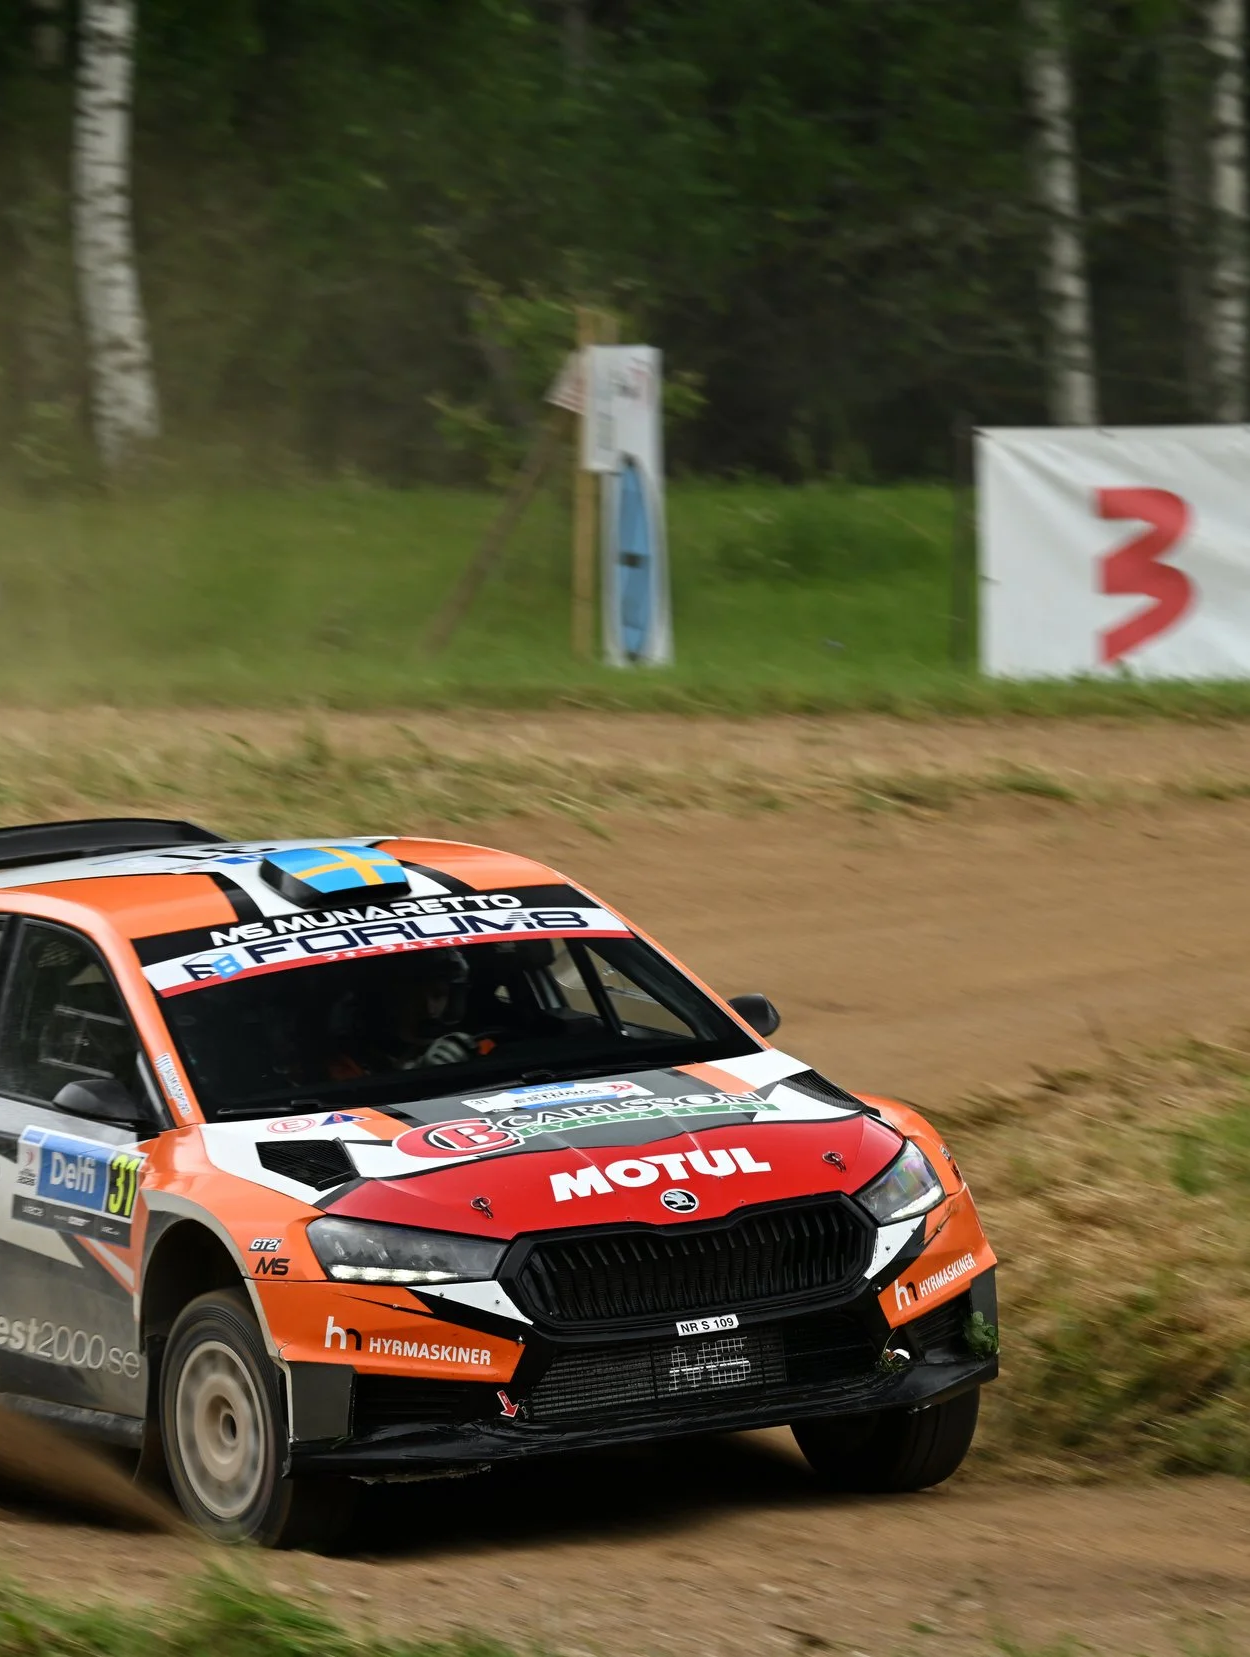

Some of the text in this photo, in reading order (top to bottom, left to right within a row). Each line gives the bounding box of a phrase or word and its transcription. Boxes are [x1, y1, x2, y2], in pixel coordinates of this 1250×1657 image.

[1093, 486, 1198, 665] 3
[209, 893, 523, 947] MS MUNARETTO
[243, 910, 589, 965] FORUM8
[498, 1091, 767, 1130] CARLSSON
[728, 1103, 769, 1112] AB
[50, 1152, 96, 1194] Delfi
[108, 1154, 141, 1216] 31
[549, 1147, 772, 1203] MOTUL
[249, 1238, 283, 1251] GT2i
[254, 1256, 291, 1276] MS
[918, 1252, 977, 1298] HYRMASKINER
[680, 1317, 734, 1334] NR S 109
[368, 1336, 491, 1366] HYRMASKINER
